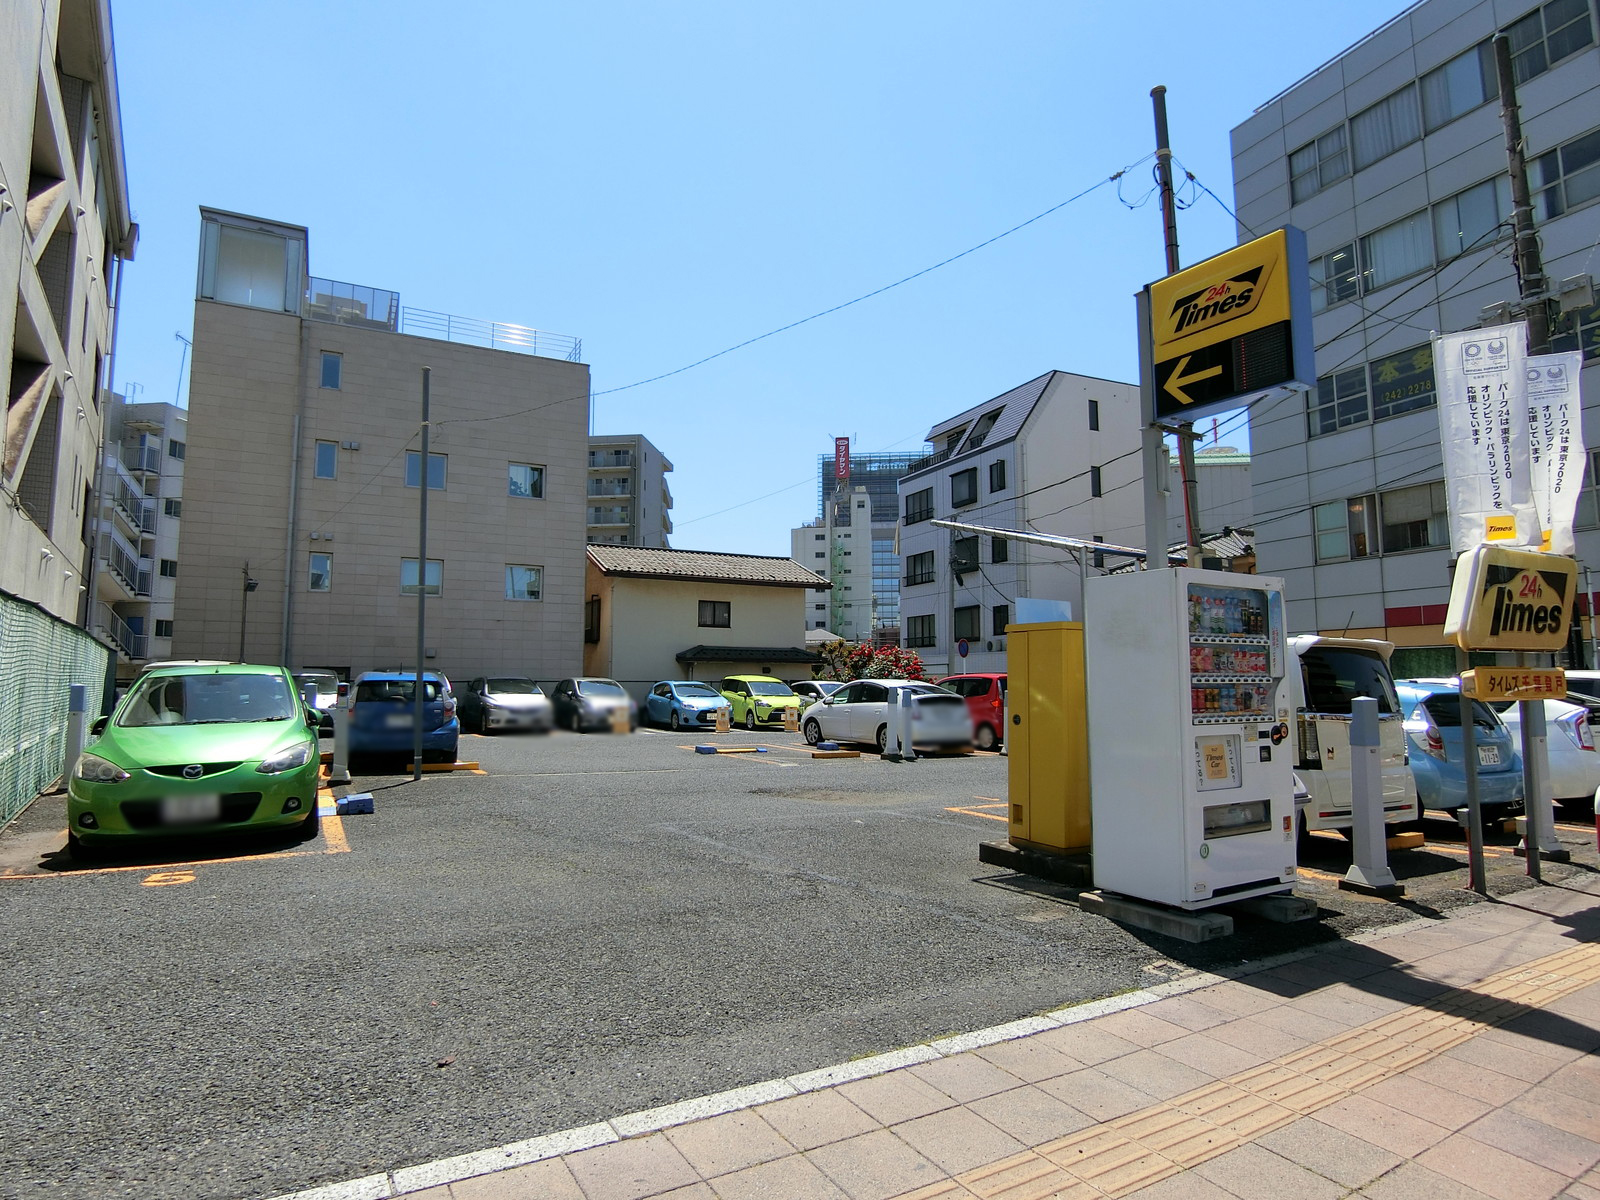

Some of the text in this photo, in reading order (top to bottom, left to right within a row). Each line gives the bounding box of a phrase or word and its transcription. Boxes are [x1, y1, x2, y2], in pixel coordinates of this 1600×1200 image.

[1173, 285, 1255, 334] Times
[1408, 380, 1432, 395] 2278
[1466, 386, 1481, 446] 応援しています
[1498, 382, 1512, 479] パーク24は東京2020
[1527, 406, 1542, 464] 応援しています
[1481, 384, 1503, 509] オリンピック・パラリンピックを
[1488, 525, 1513, 533] Times
[1489, 586, 1563, 636] Times
